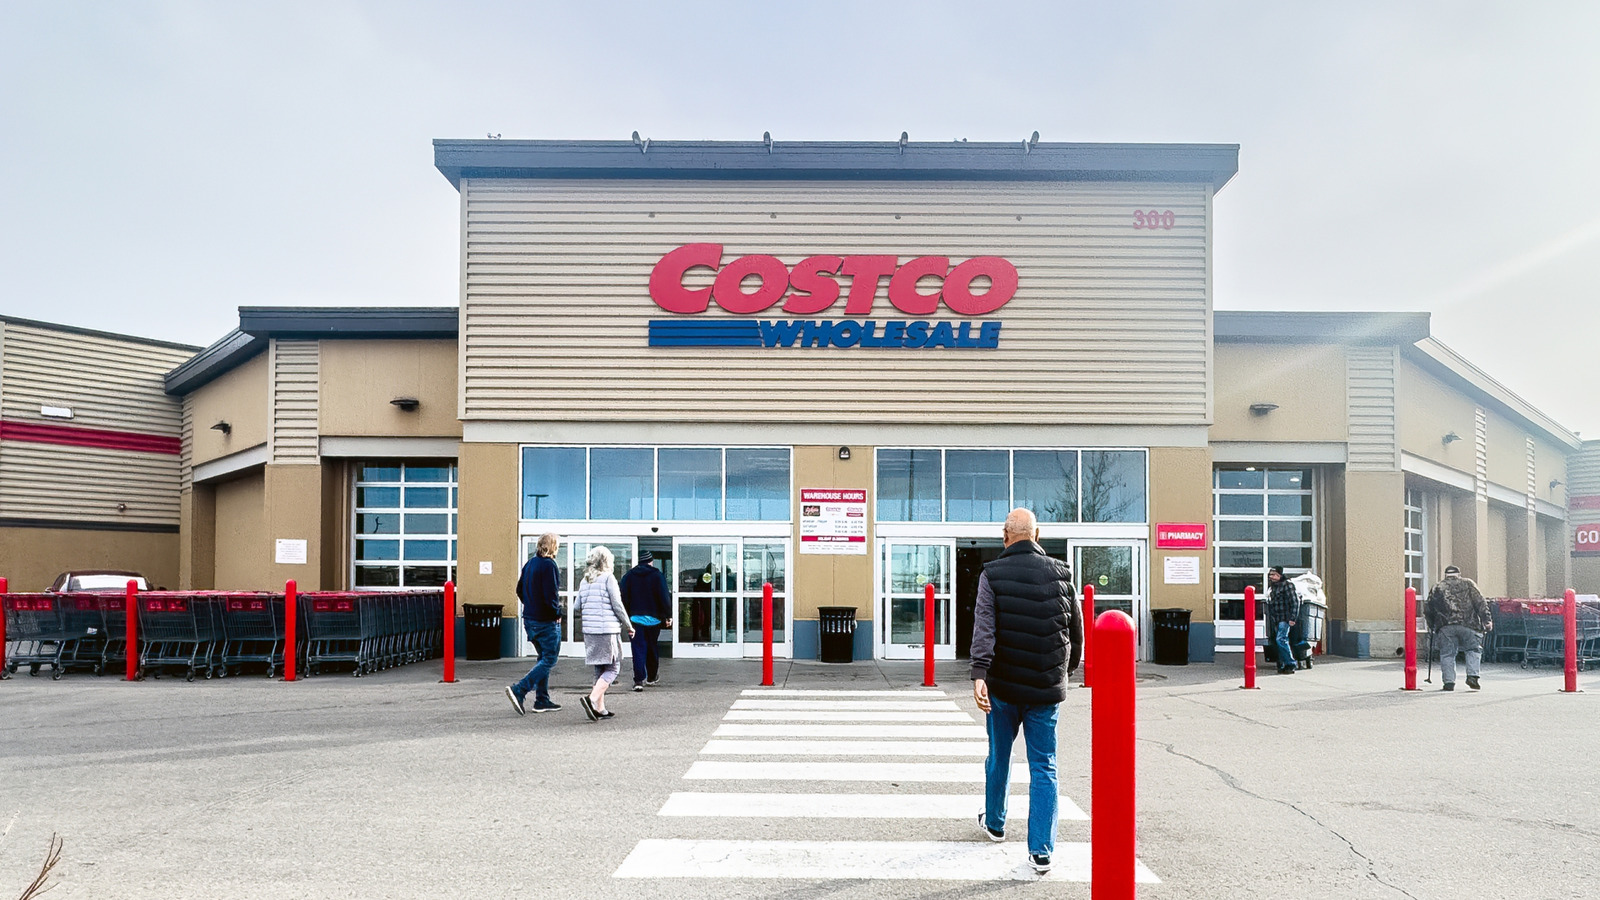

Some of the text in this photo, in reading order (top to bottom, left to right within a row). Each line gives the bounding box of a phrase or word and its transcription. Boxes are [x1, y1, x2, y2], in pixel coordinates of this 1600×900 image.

[1132, 209, 1175, 230] 300
[648, 242, 1019, 316] COSTCO
[759, 320, 1002, 349] WHOLESALE
[803, 492, 863, 500] WAREHOUSE HOURS
[1167, 532, 1204, 540] PHARMACY
